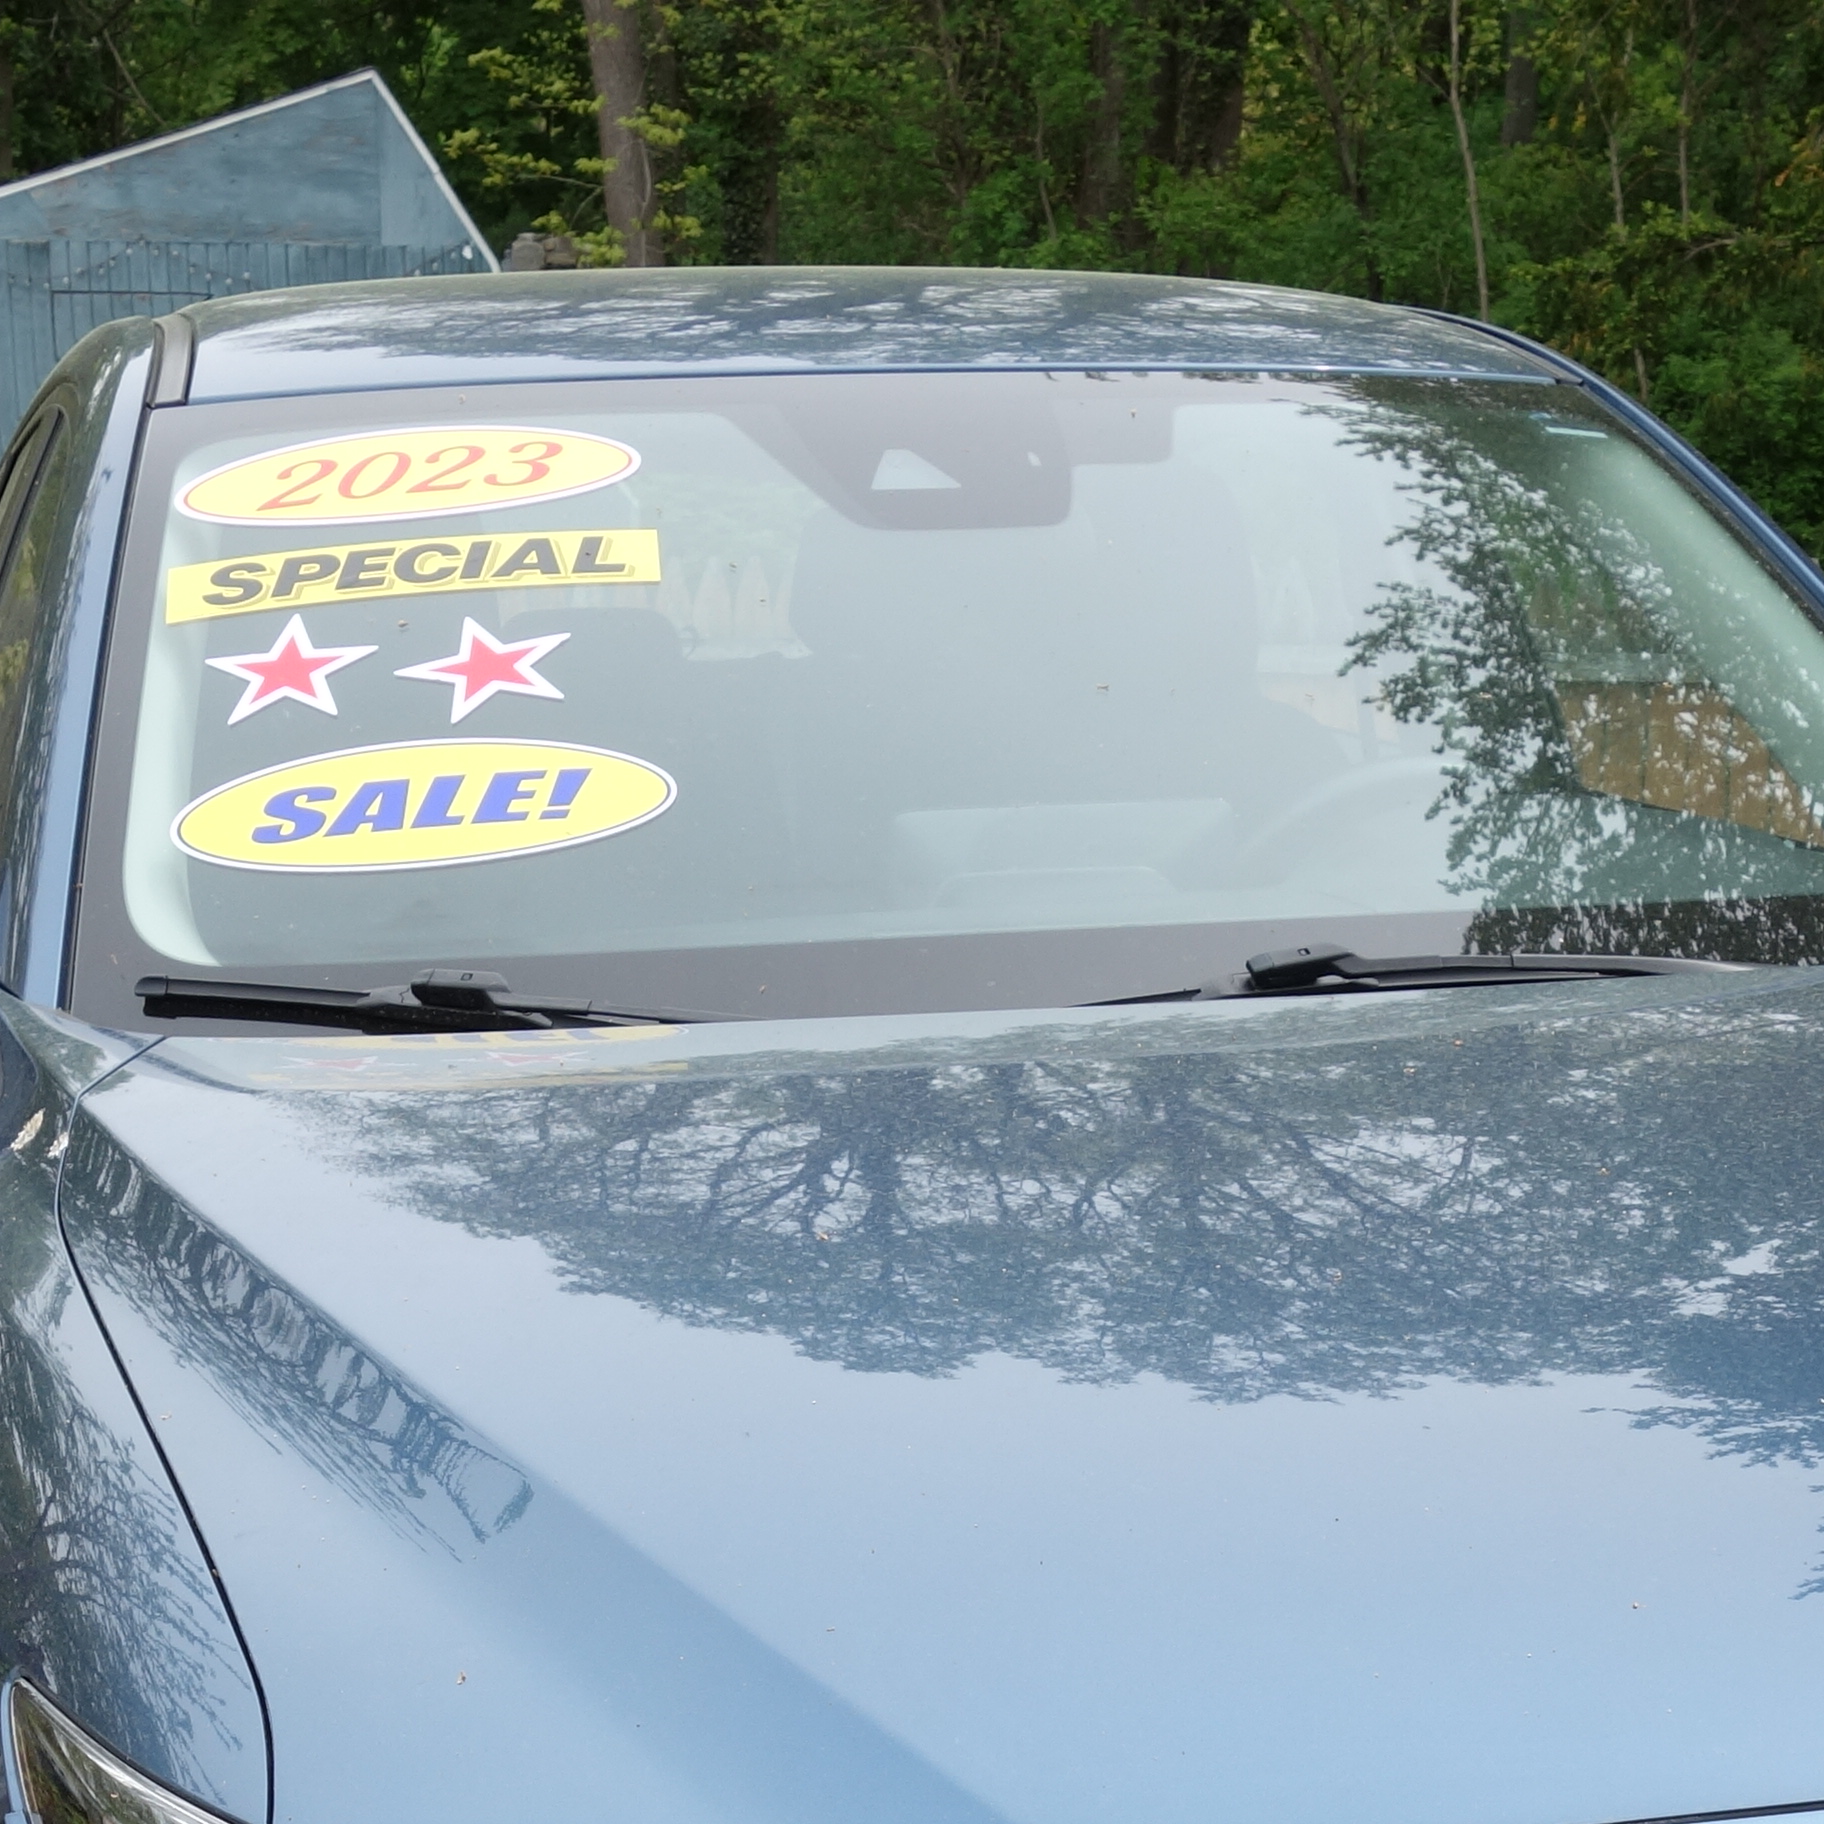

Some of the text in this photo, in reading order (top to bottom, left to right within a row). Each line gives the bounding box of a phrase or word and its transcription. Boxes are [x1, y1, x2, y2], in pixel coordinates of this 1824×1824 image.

[255, 441, 564, 512] 2023
[201, 535, 629, 607] SPECIAL
[250, 767, 593, 845] SALE!
